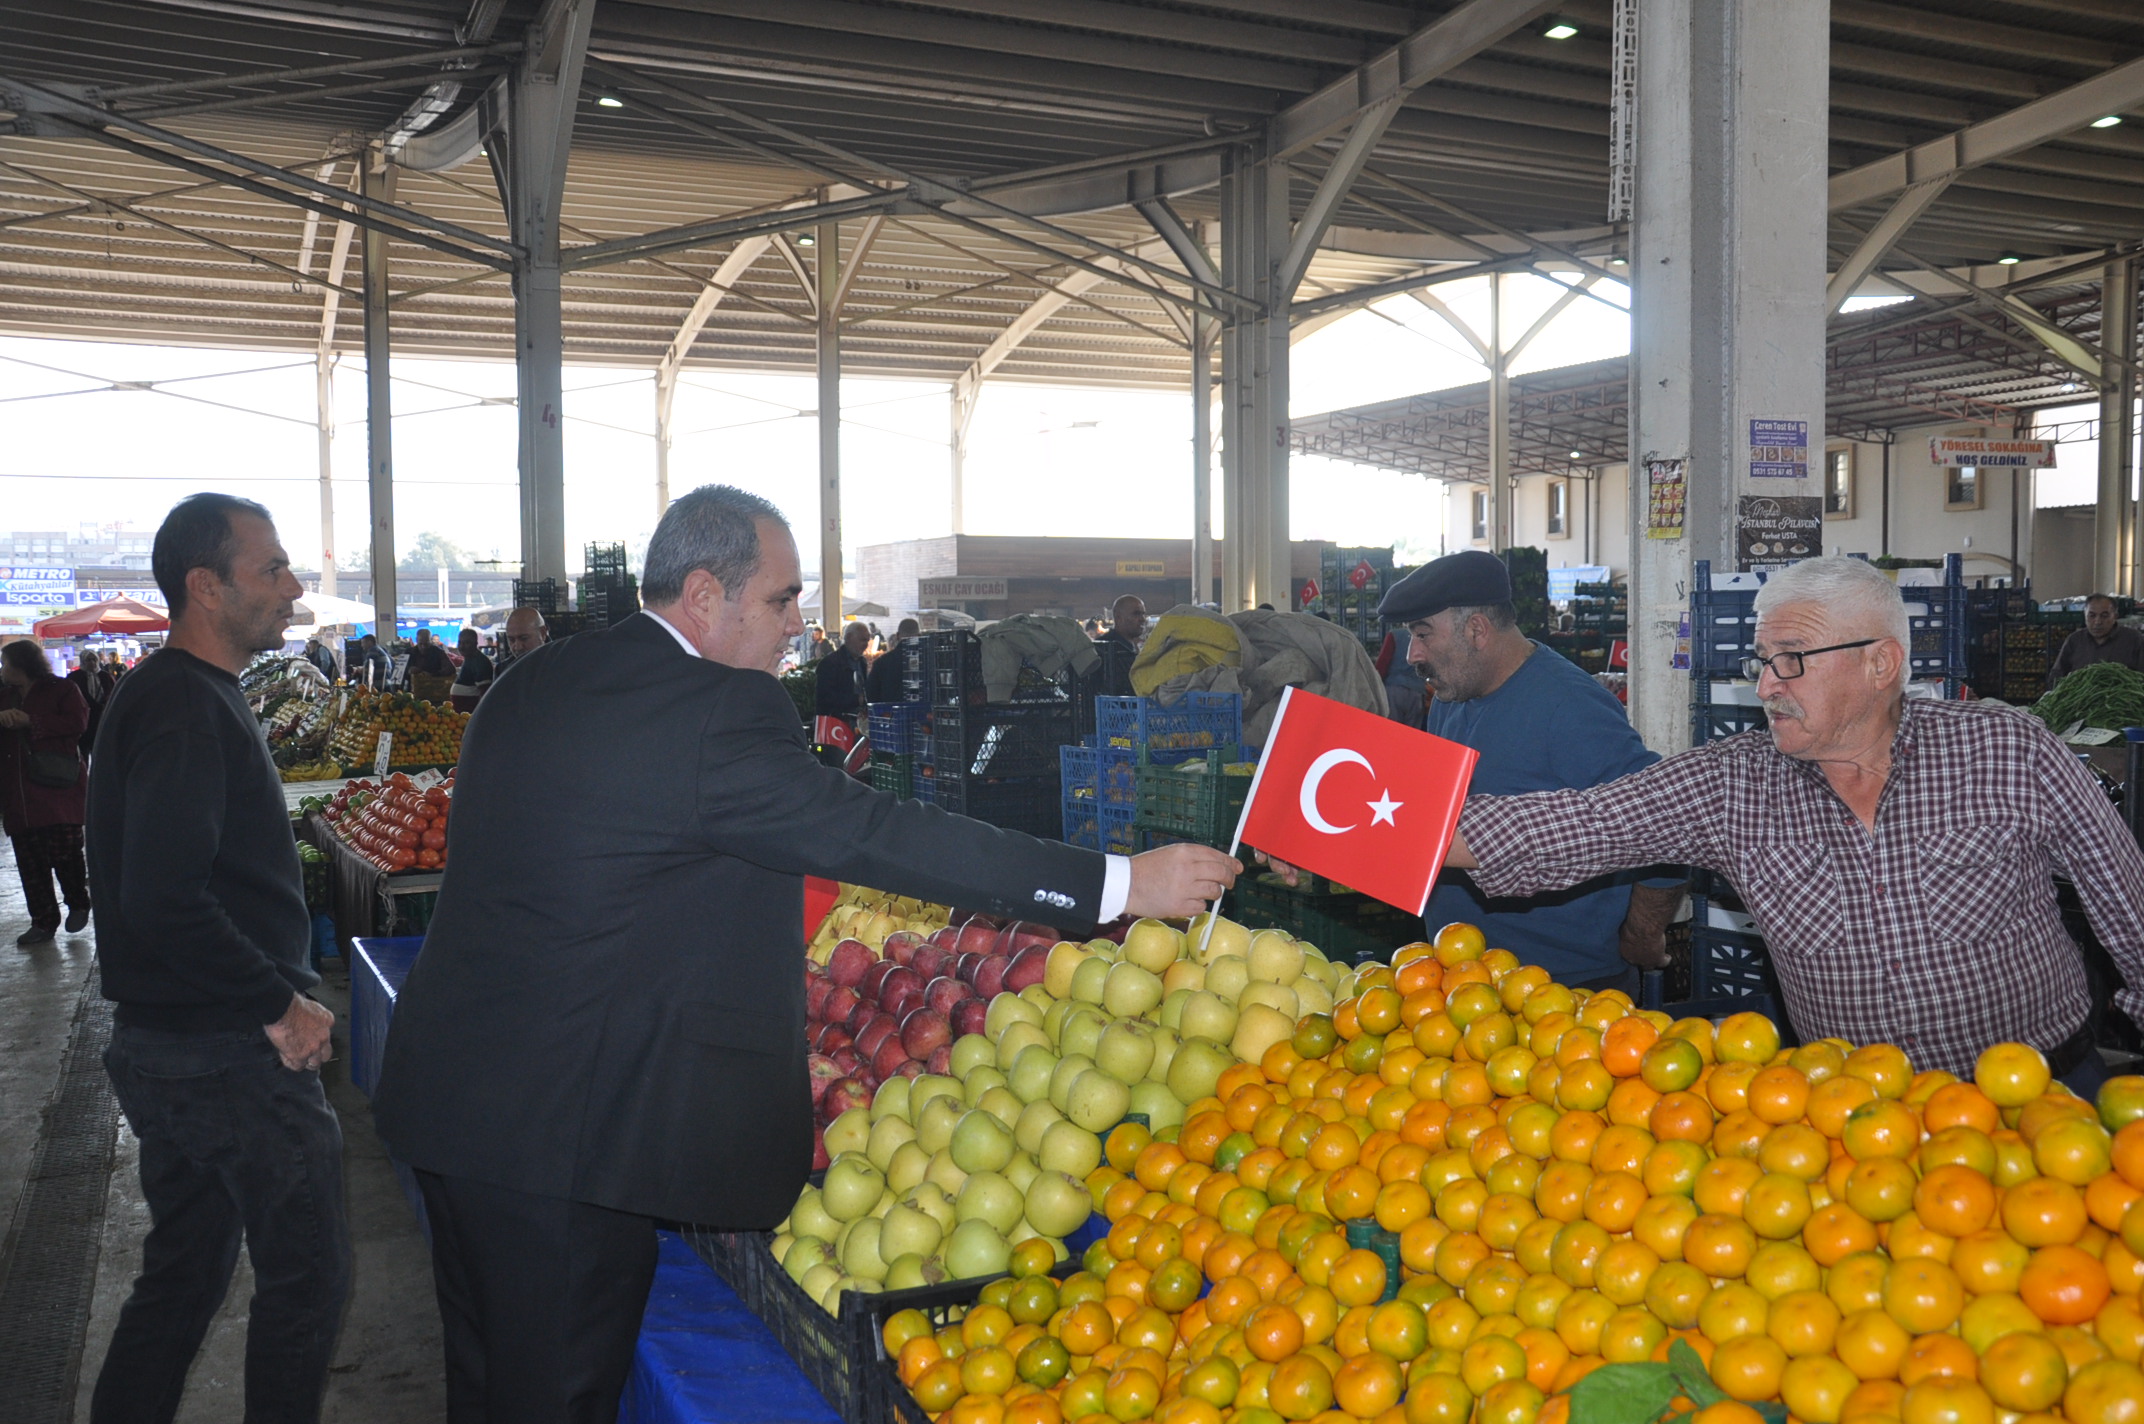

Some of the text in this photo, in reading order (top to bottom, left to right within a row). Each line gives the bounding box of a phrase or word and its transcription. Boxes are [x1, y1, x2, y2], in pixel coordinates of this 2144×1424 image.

[542, 403, 556, 429] 4
[1755, 422, 1797, 431] Ceren Tost Evi
[1276, 426, 1285, 447] 3
[1940, 440, 2043, 453] YÖRESEL SOKAĞINA
[1956, 454, 2028, 466] HOŞ GELDİNİZ
[829, 518, 836, 531] 3
[13, 568, 71, 579] METRO
[11, 580, 72, 591] Kütahyalılar
[923, 582, 1004, 597] ESNAF ÇAY OCAĞI
[6, 592, 66, 604] Isparta
